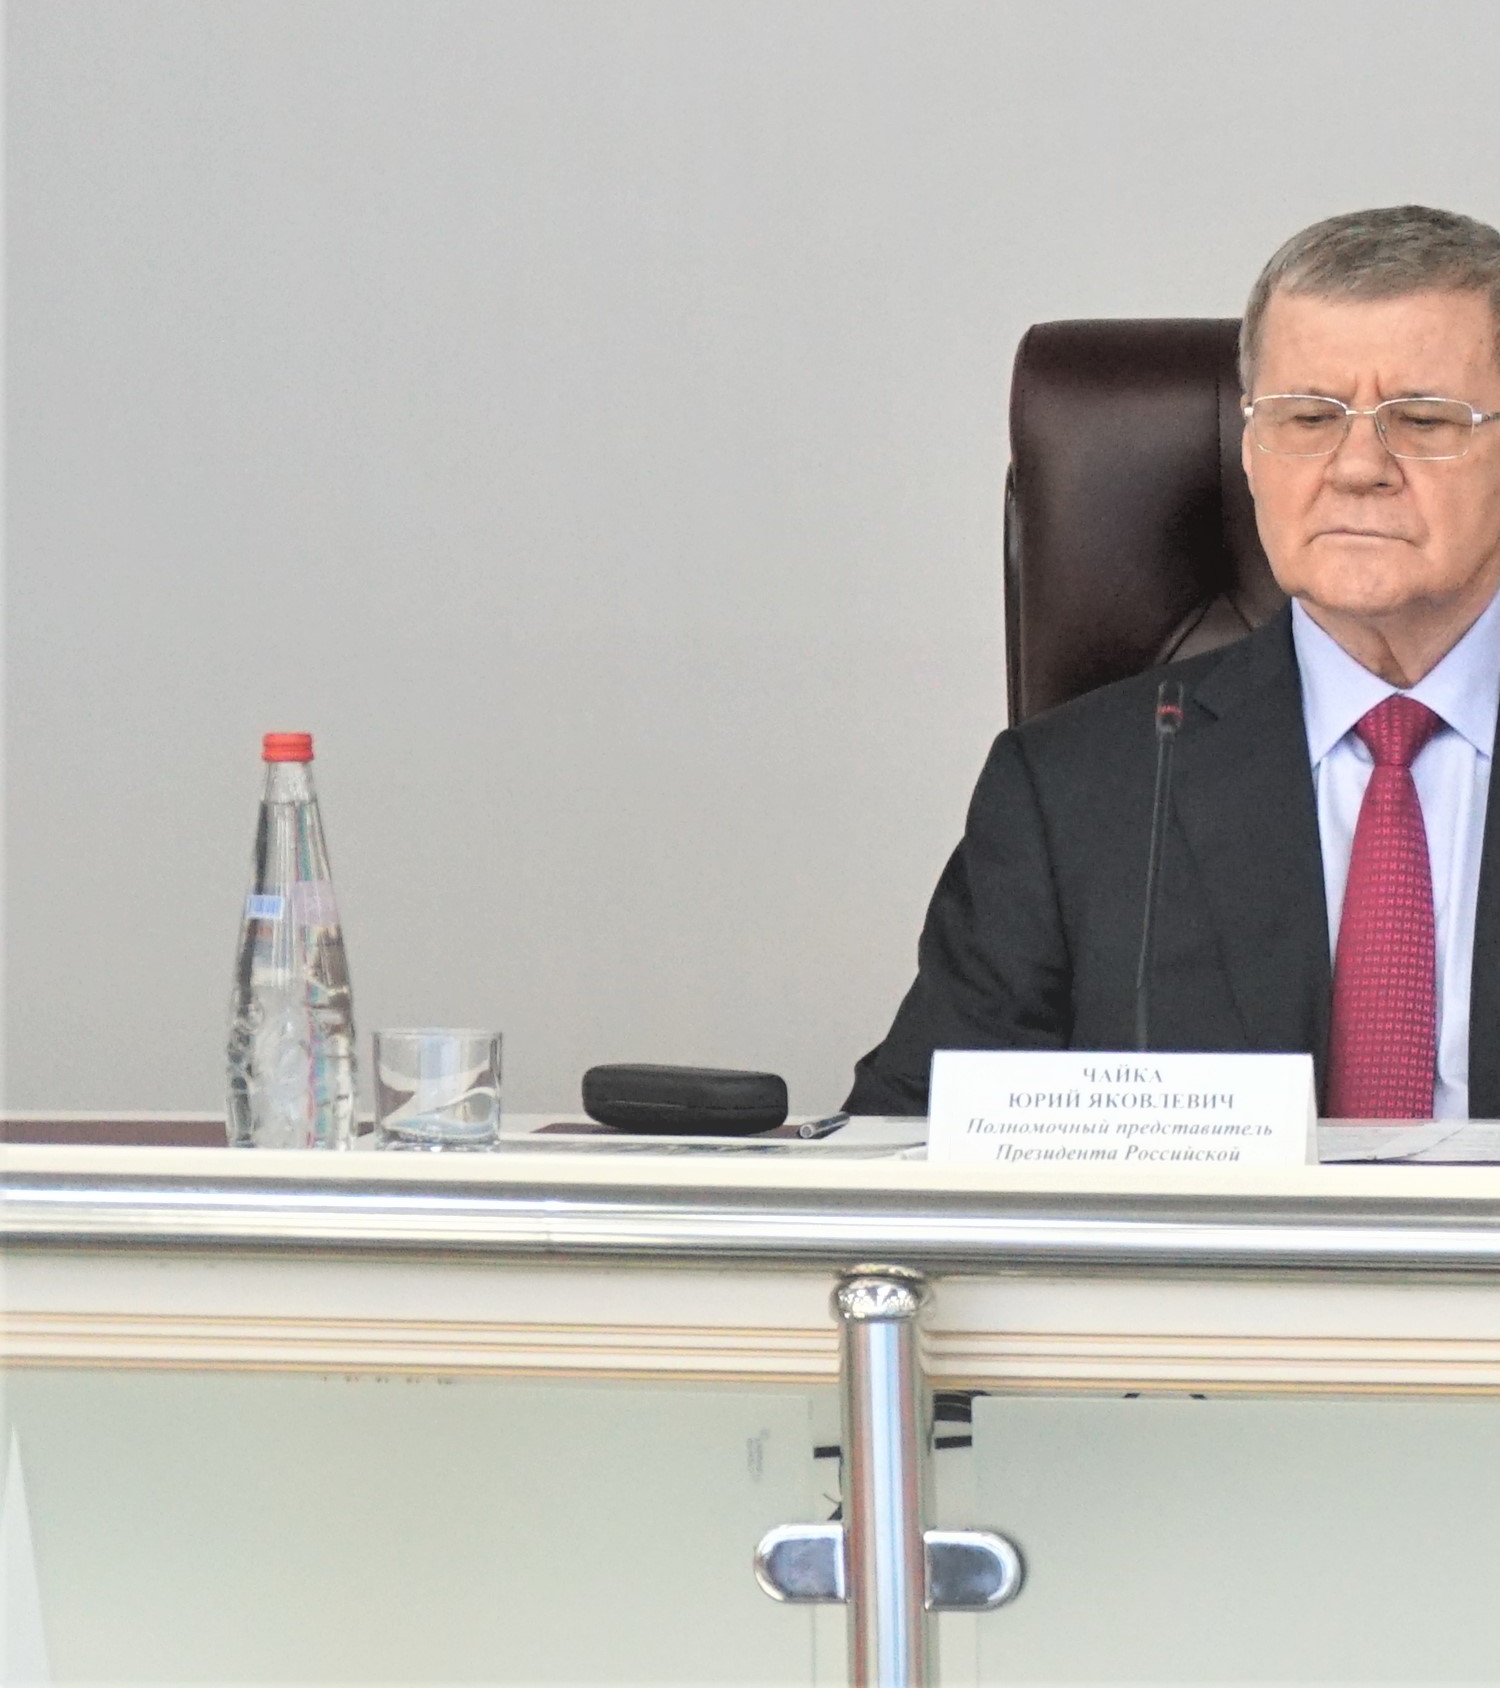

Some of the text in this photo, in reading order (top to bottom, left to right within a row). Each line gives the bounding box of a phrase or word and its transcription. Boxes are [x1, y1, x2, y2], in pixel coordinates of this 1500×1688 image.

[1082, 1064, 1163, 1083] ЧАЙКА
[1008, 1089, 1235, 1110] ЮРИЙ ЯКОВЛЕВИЧ
[966, 1117, 1273, 1139] Полномочный представитель
[995, 1143, 1241, 1163] Президента Российской
